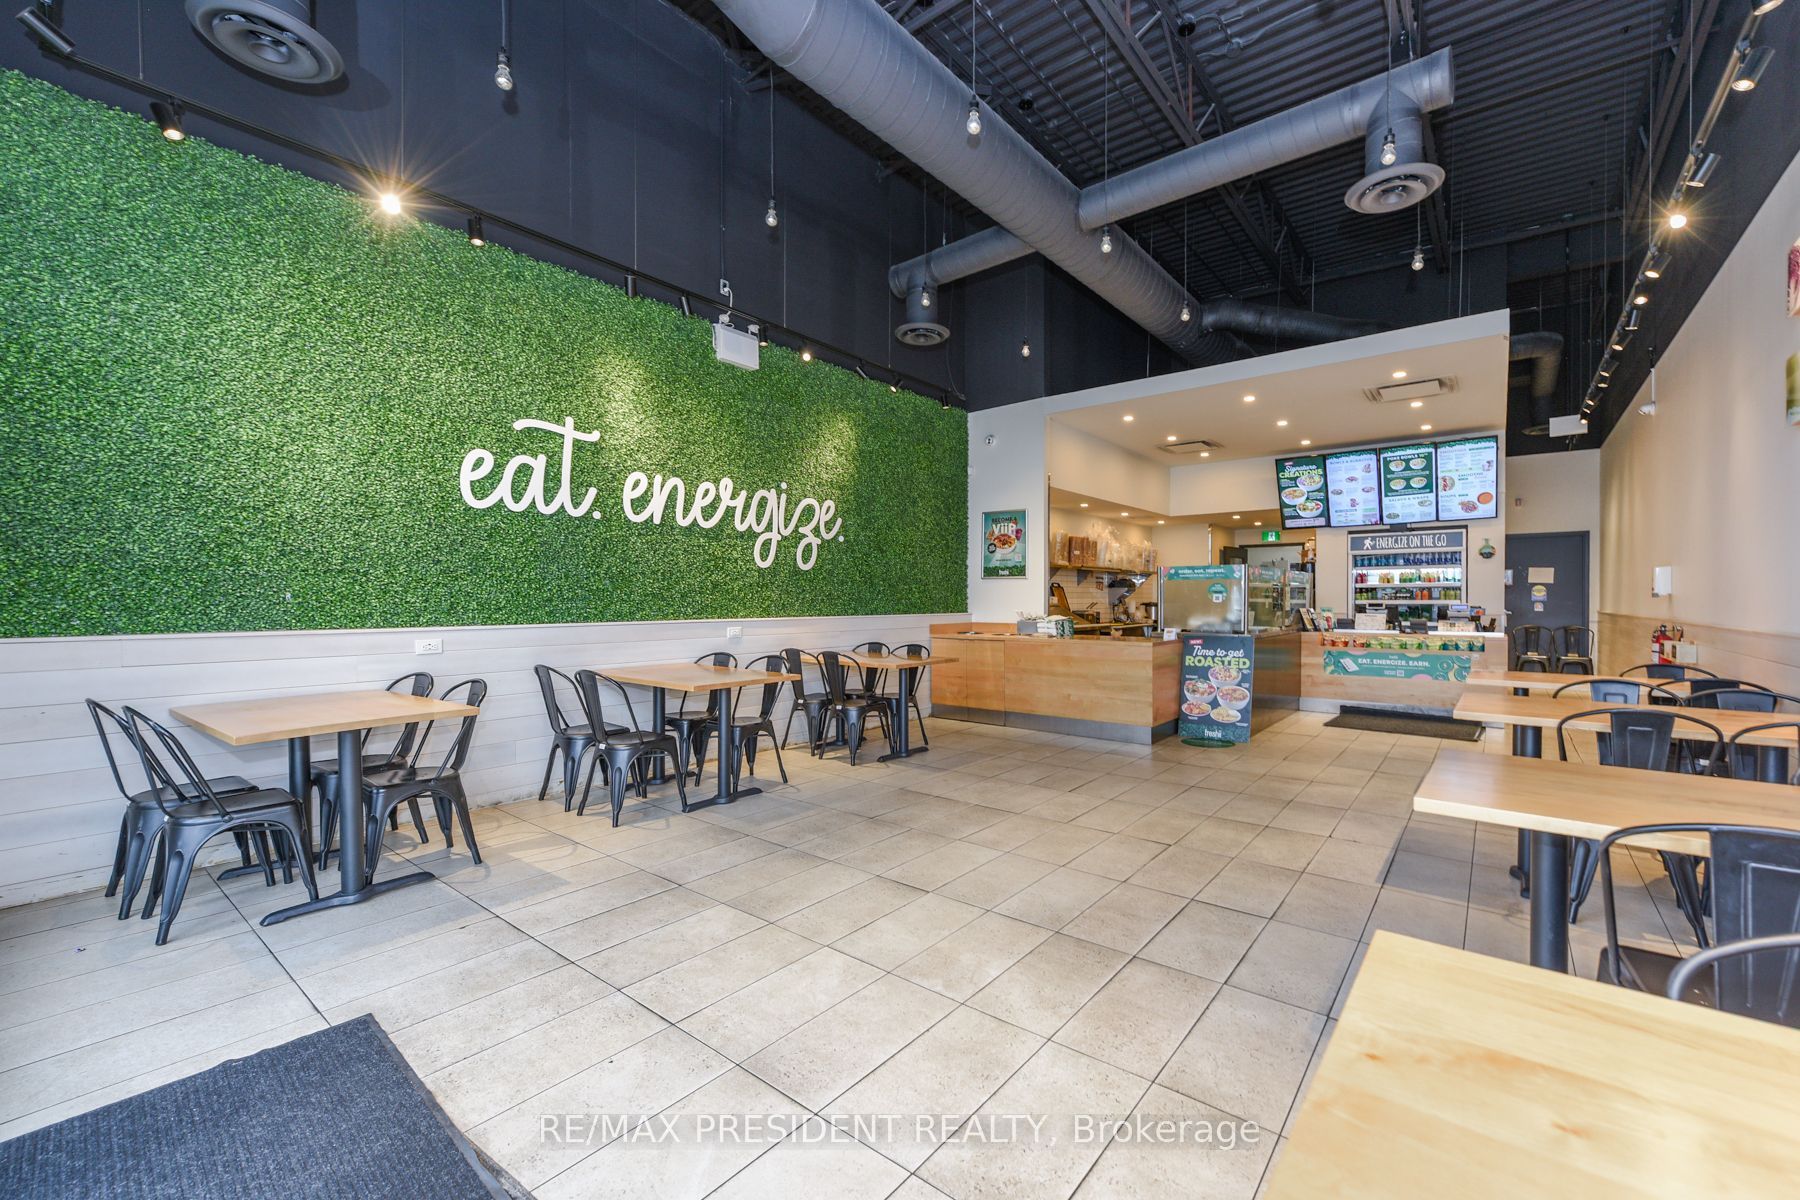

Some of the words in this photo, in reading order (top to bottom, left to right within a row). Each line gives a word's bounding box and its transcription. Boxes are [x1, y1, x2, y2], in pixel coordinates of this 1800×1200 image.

[1279, 469, 1322, 478] CREATIONS
[459, 416, 602, 520] eat.
[622, 471, 844, 571] energize.
[1376, 536, 1408, 549] ENERGIZE
[1409, 535, 1420, 548] ON
[1422, 535, 1434, 547] THE
[1435, 534, 1446, 546] GO
[1193, 646, 1215, 656] Time
[1216, 648, 1228, 656] to
[1228, 649, 1244, 660] get
[1185, 656, 1250, 668] ROASTED
